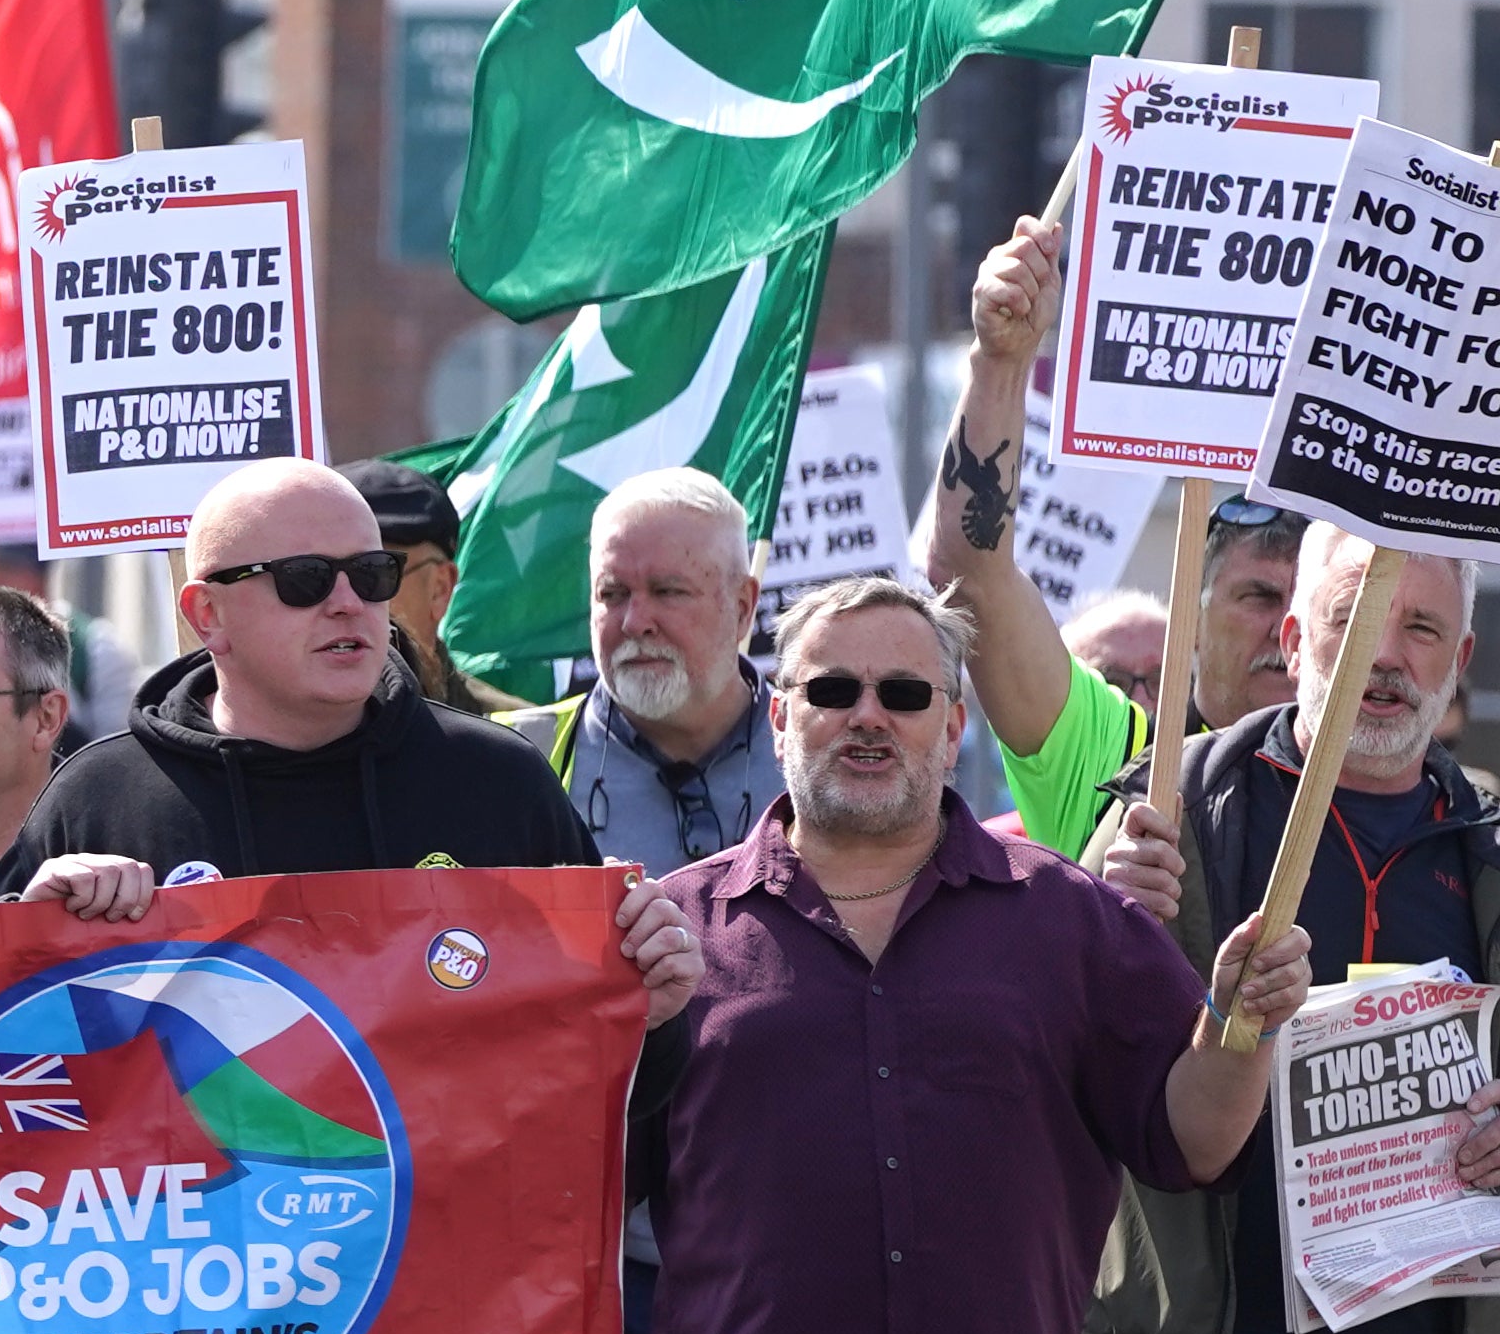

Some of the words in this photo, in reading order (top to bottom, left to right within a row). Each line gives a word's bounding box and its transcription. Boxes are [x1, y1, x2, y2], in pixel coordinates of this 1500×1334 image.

[1146, 83, 1290, 117] Socialist
[75, 175, 217, 202] Socialist
[1109, 164, 1337, 224] REINSTATE
[1352, 190, 1417, 236] NO
[1430, 217, 1485, 264] TO
[54, 246, 282, 301] REINSTATE
[1112, 220, 1212, 278] THE
[1218, 230, 1315, 288] 800
[1337, 239, 1465, 312] MORE
[62, 308, 159, 365] THE
[171, 300, 284, 355] 800!
[1105, 308, 1297, 359] NATIONALIS
[1322, 286, 1450, 357] FIGHT
[1124, 345, 1199, 384] P&O
[1307, 335, 1453, 409] EVERY
[74, 387, 283, 433] NATIONALISE
[99, 426, 168, 464] P&O
[174, 422, 261, 457] NOW!
[1299, 402, 1368, 448] Stop
[1373, 430, 1433, 466] this
[1437, 449, 1500, 476] race
[1291, 434, 1325, 461] to
[1331, 446, 1380, 485] the
[1384, 466, 1500, 507] bottom
[805, 492, 864, 519] FOR
[1383, 511, 1500, 536] www.socialistworker.co.
[60, 519, 191, 544] www.socialist
[826, 525, 877, 556] JOB
[1027, 530, 1084, 568] FOR
[432, 944, 479, 981] P&O
[1329, 1017, 1354, 1036] the
[1353, 981, 1495, 1028] Socialist
[1303, 1075, 1422, 1138] TORIES
[1307, 1147, 1338, 1169] Trade
[1340, 1142, 1379, 1160] unions
[1380, 1135, 1410, 1151] must
[1411, 1122, 1462, 1145] organise
[1308, 1171, 1320, 1187] to
[1322, 1164, 1345, 1183] kick
[1347, 1161, 1366, 1177] out
[1368, 1156, 1387, 1172] the
[1389, 1150, 1423, 1166] Tories
[281, 1192, 358, 1217] RMT
[1309, 1189, 1338, 1208] Build
[1340, 1188, 1347, 1199] a
[1348, 1181, 1371, 1197] new
[1372, 1173, 1402, 1191] mass
[1312, 1209, 1333, 1227] and
[1334, 1199, 1360, 1223] fight
[1361, 1198, 1377, 1213] for
[1379, 1183, 1429, 1210] socialist
[143, 1241, 344, 1317] JOBS
